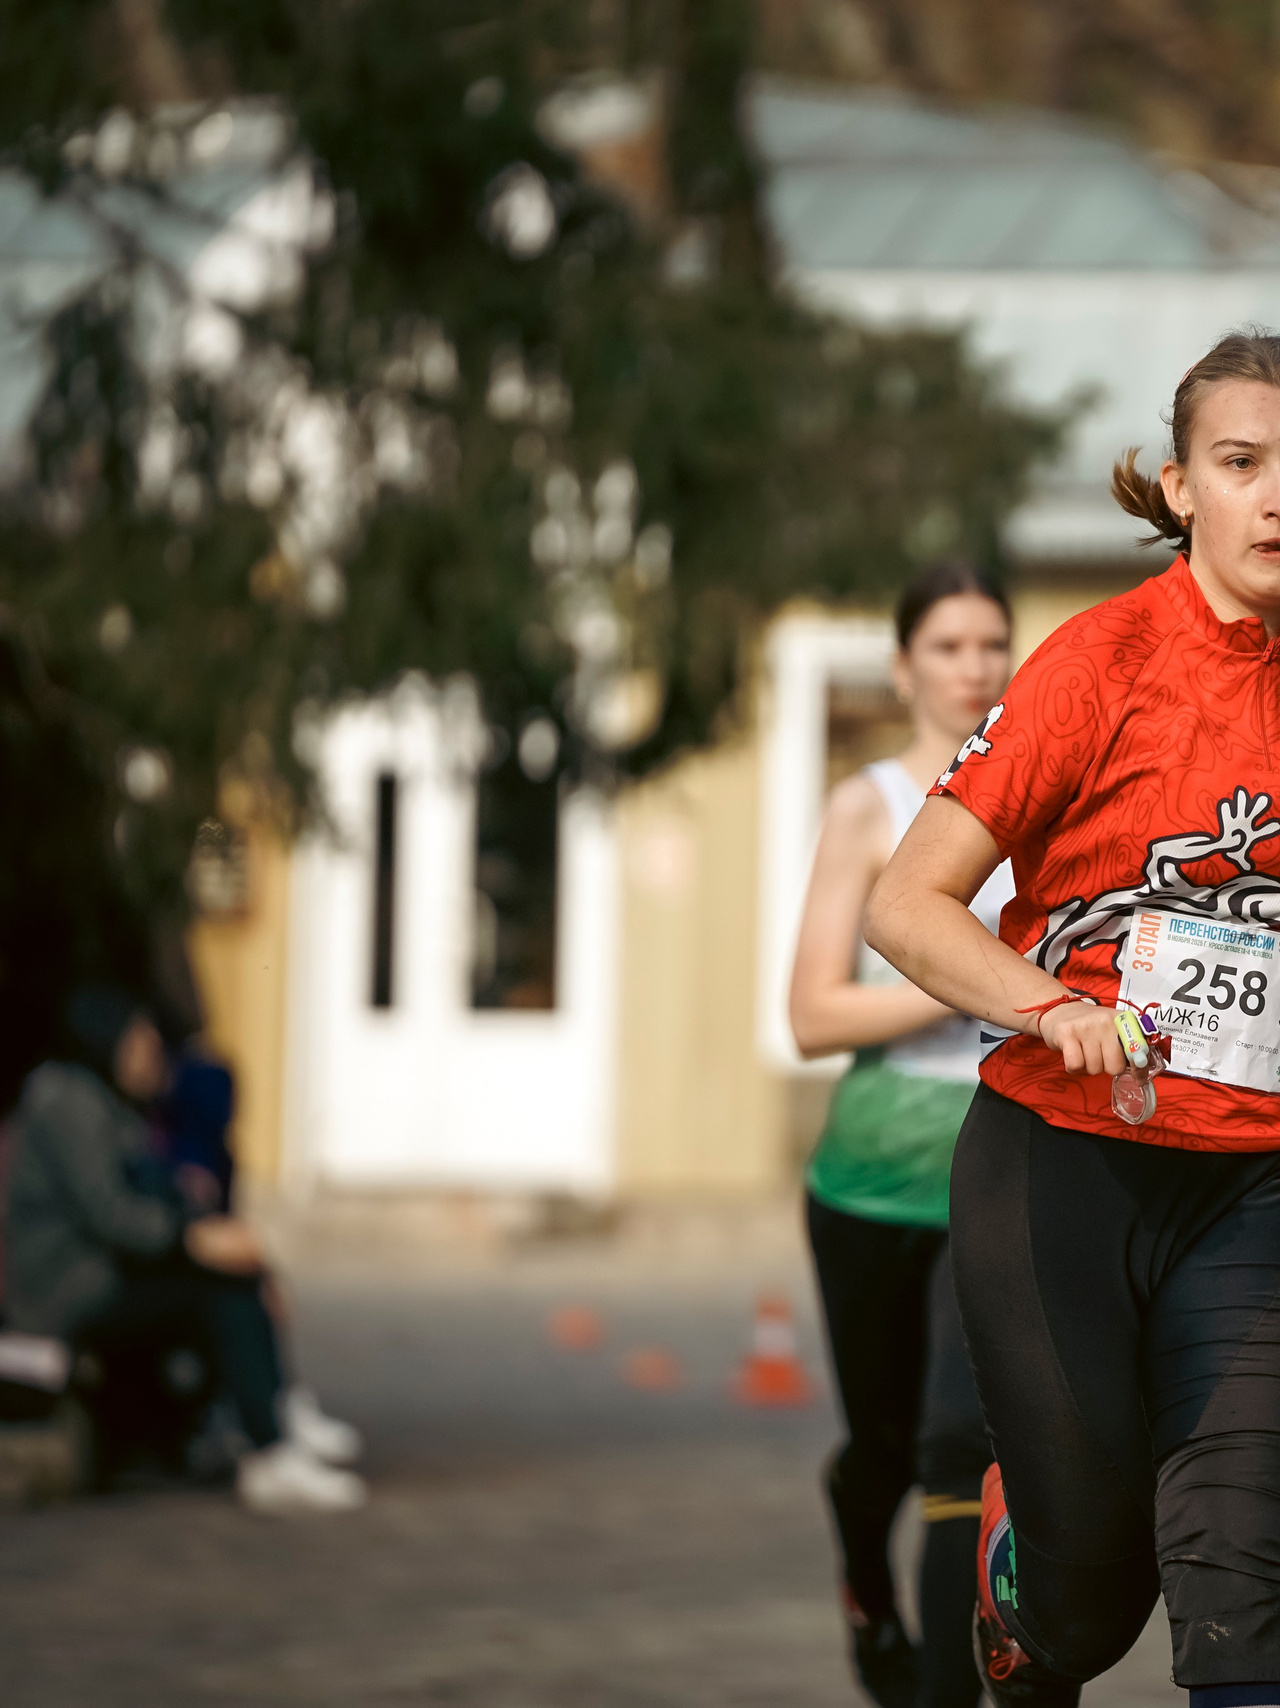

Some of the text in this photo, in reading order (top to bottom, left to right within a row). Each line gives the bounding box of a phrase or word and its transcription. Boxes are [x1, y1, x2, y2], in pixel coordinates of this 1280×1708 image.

[1132, 913, 1162, 973] 3 ЭТАП
[1169, 918, 1276, 951] ПЕРВЕНСТВО РОССИИ
[1171, 934, 1191, 945] НОЯБРЯ
[1170, 958, 1268, 1017] 258
[1155, 1005, 1220, 1032] МЖ16
[1185, 1029, 1219, 1042] Елизавета
[1235, 1040, 1253, 1050] Старт
